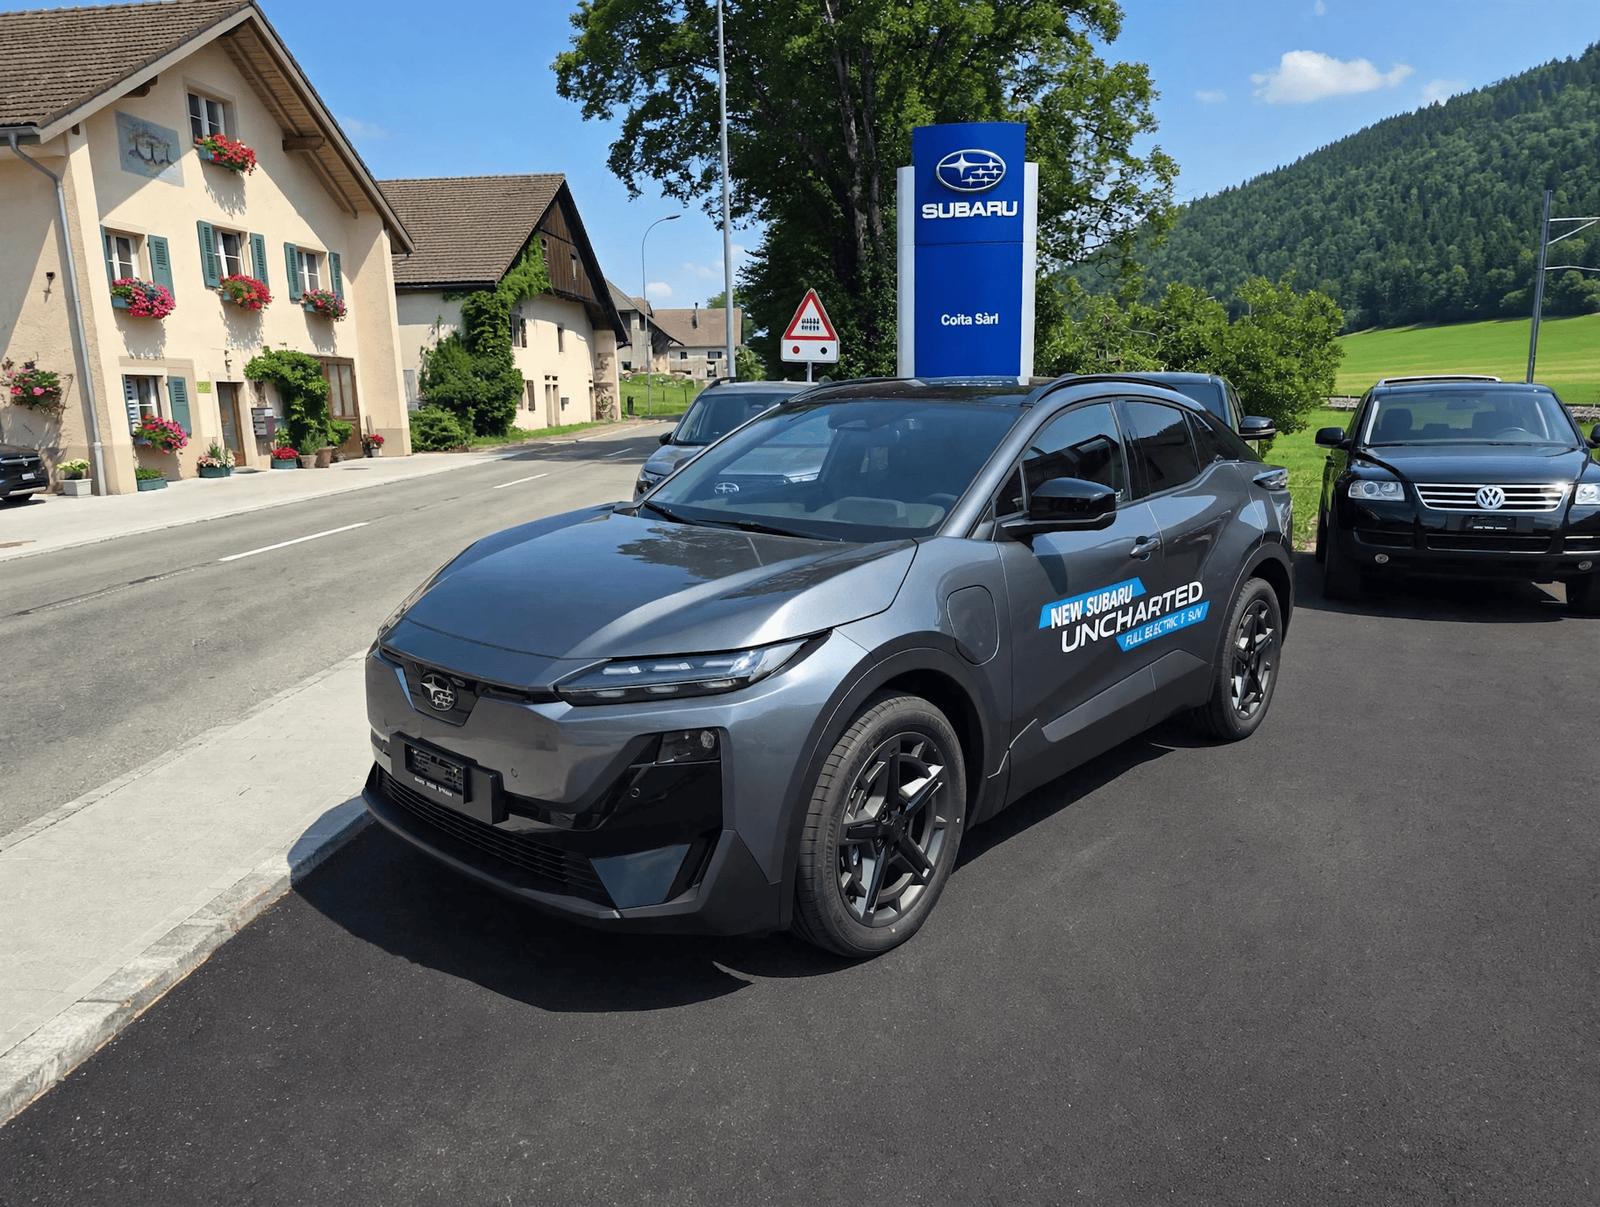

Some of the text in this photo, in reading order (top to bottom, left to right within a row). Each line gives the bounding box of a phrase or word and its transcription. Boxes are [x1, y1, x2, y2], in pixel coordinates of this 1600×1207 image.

[922, 201, 1018, 219] SUBARU
[941, 312, 999, 326] Coita Sàrl
[1051, 584, 1133, 629] NEW SUBARU
[1061, 581, 1203, 653] UNCHARTED
[1125, 629, 1143, 647] FULL
